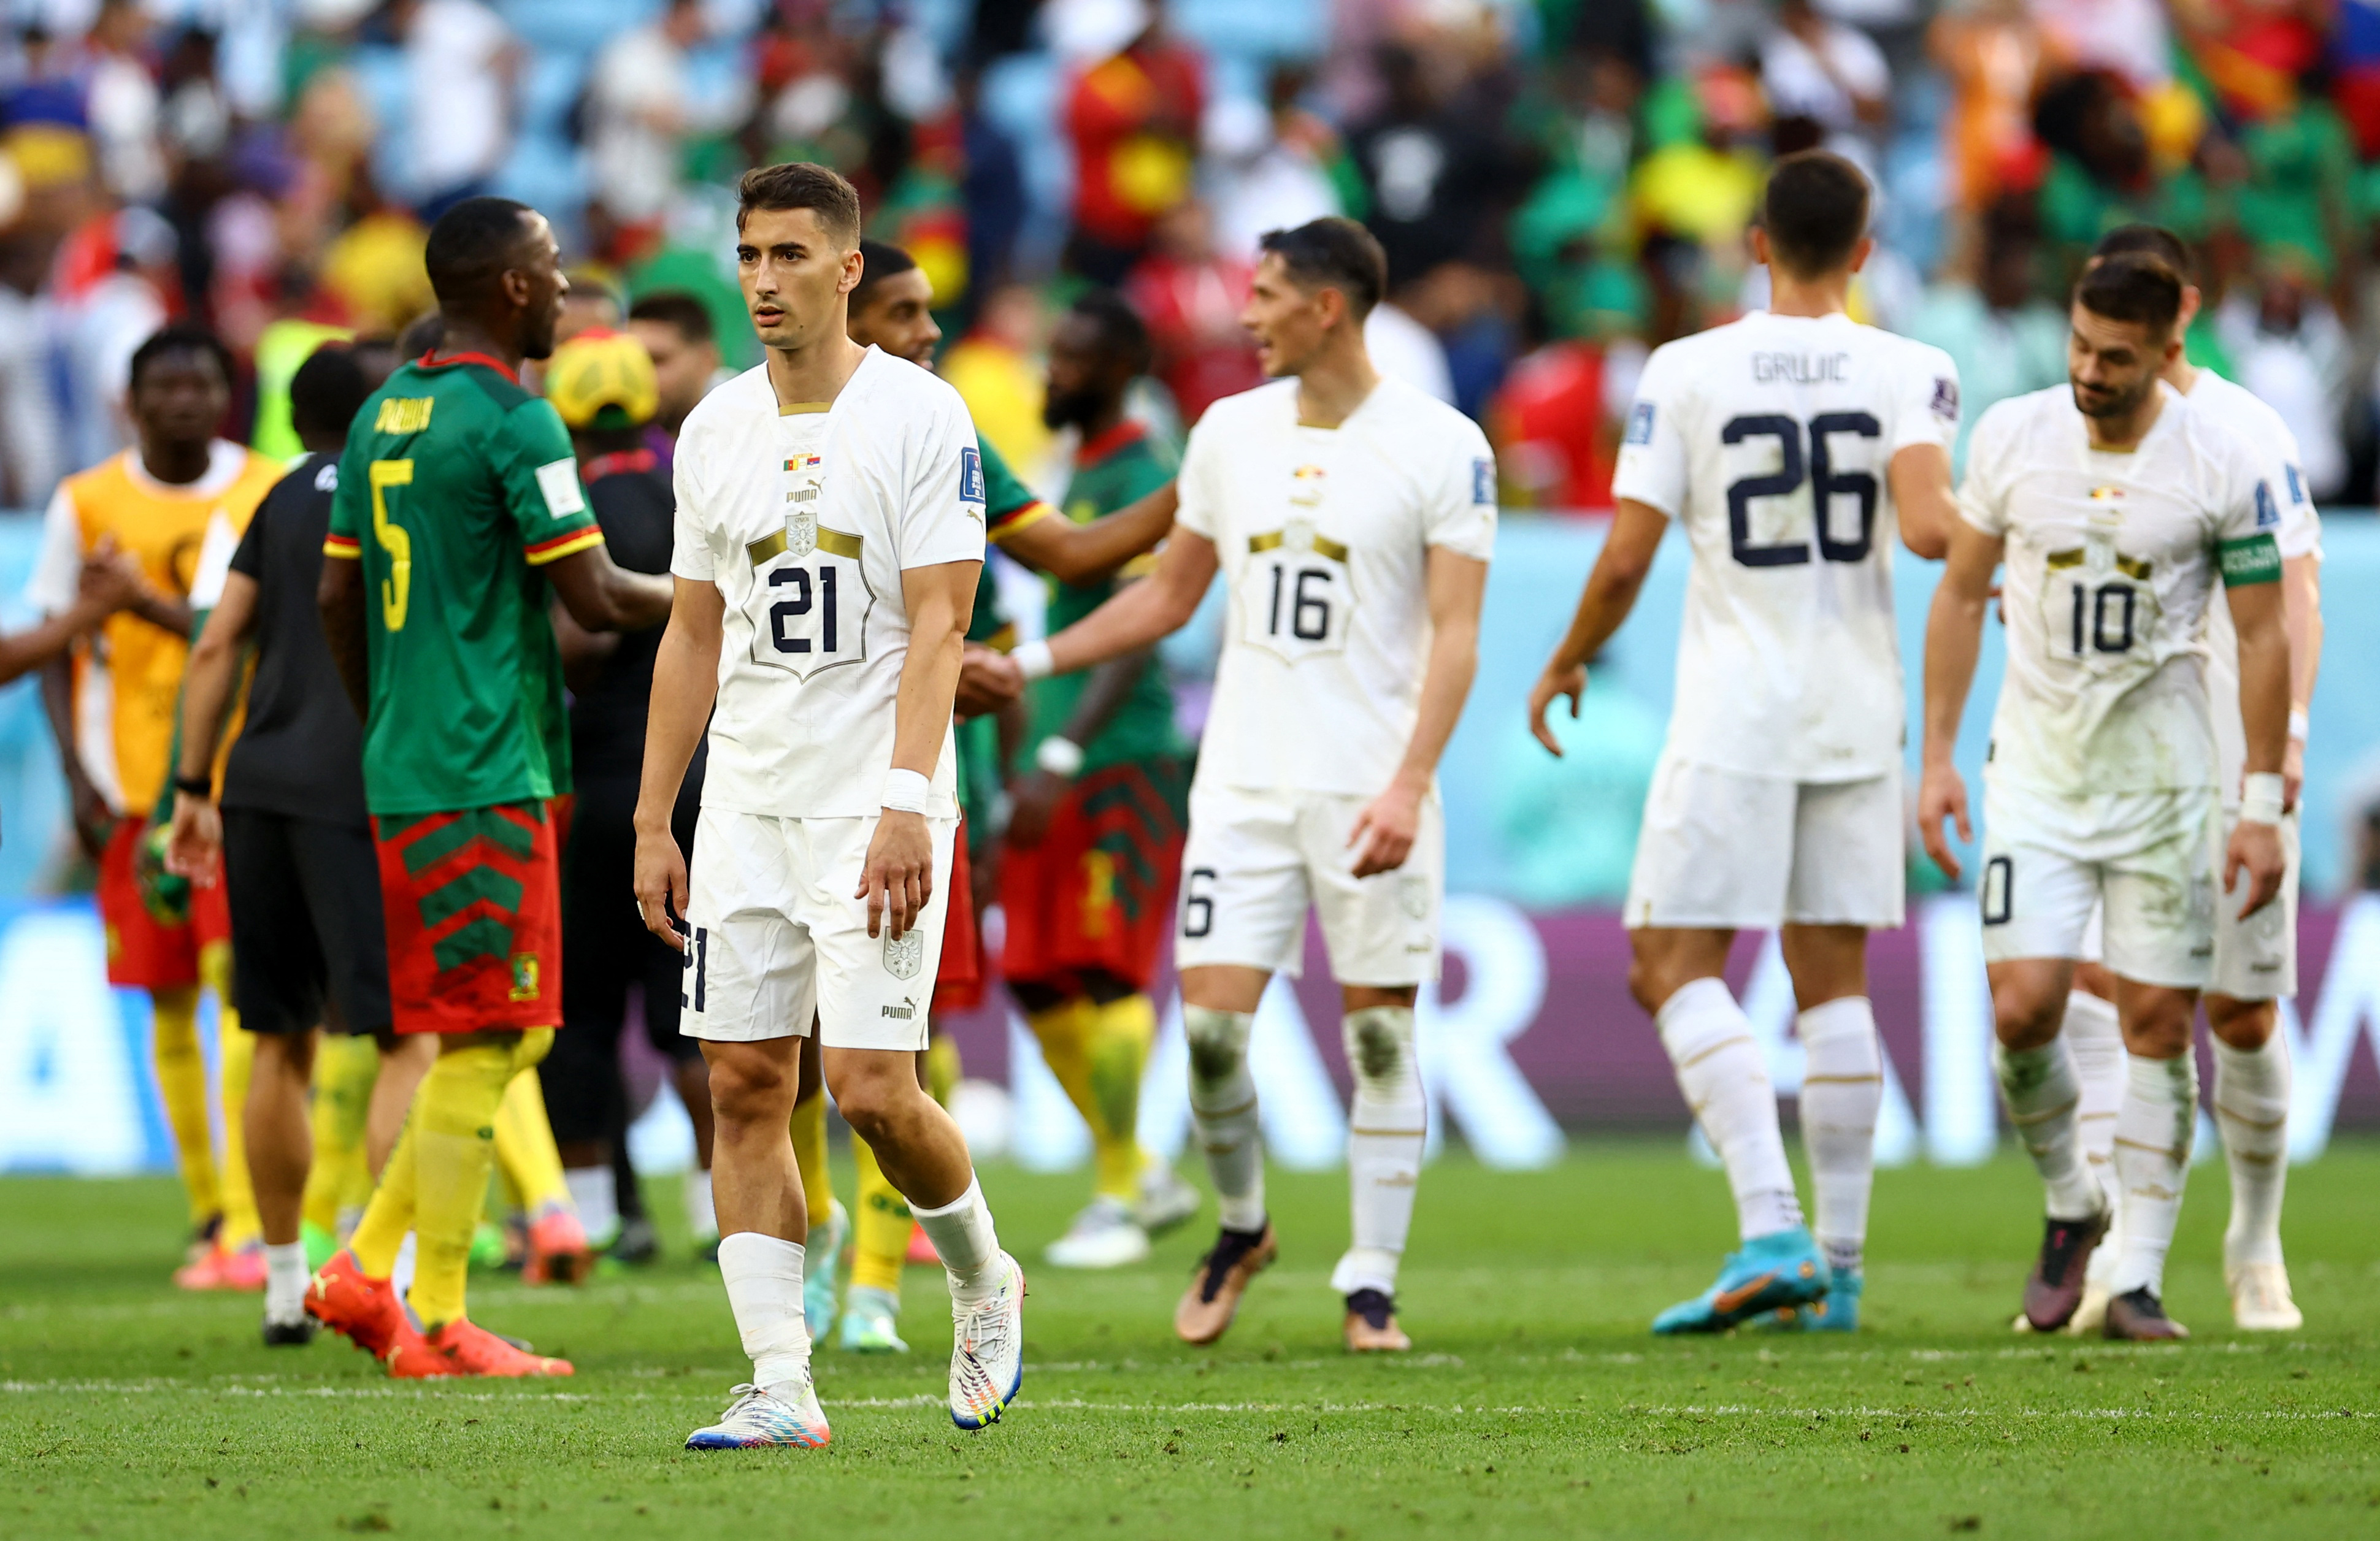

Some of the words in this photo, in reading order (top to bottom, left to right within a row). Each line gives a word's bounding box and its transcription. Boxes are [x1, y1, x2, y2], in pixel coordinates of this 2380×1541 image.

[786, 489, 817, 503] PUMA
[1721, 411, 1881, 568] 26
[370, 459, 414, 632] 5
[768, 566, 837, 654] 21
[1269, 564, 1333, 641] 16
[2072, 581, 2138, 656] 10
[881, 1005, 913, 1020] PUMA
